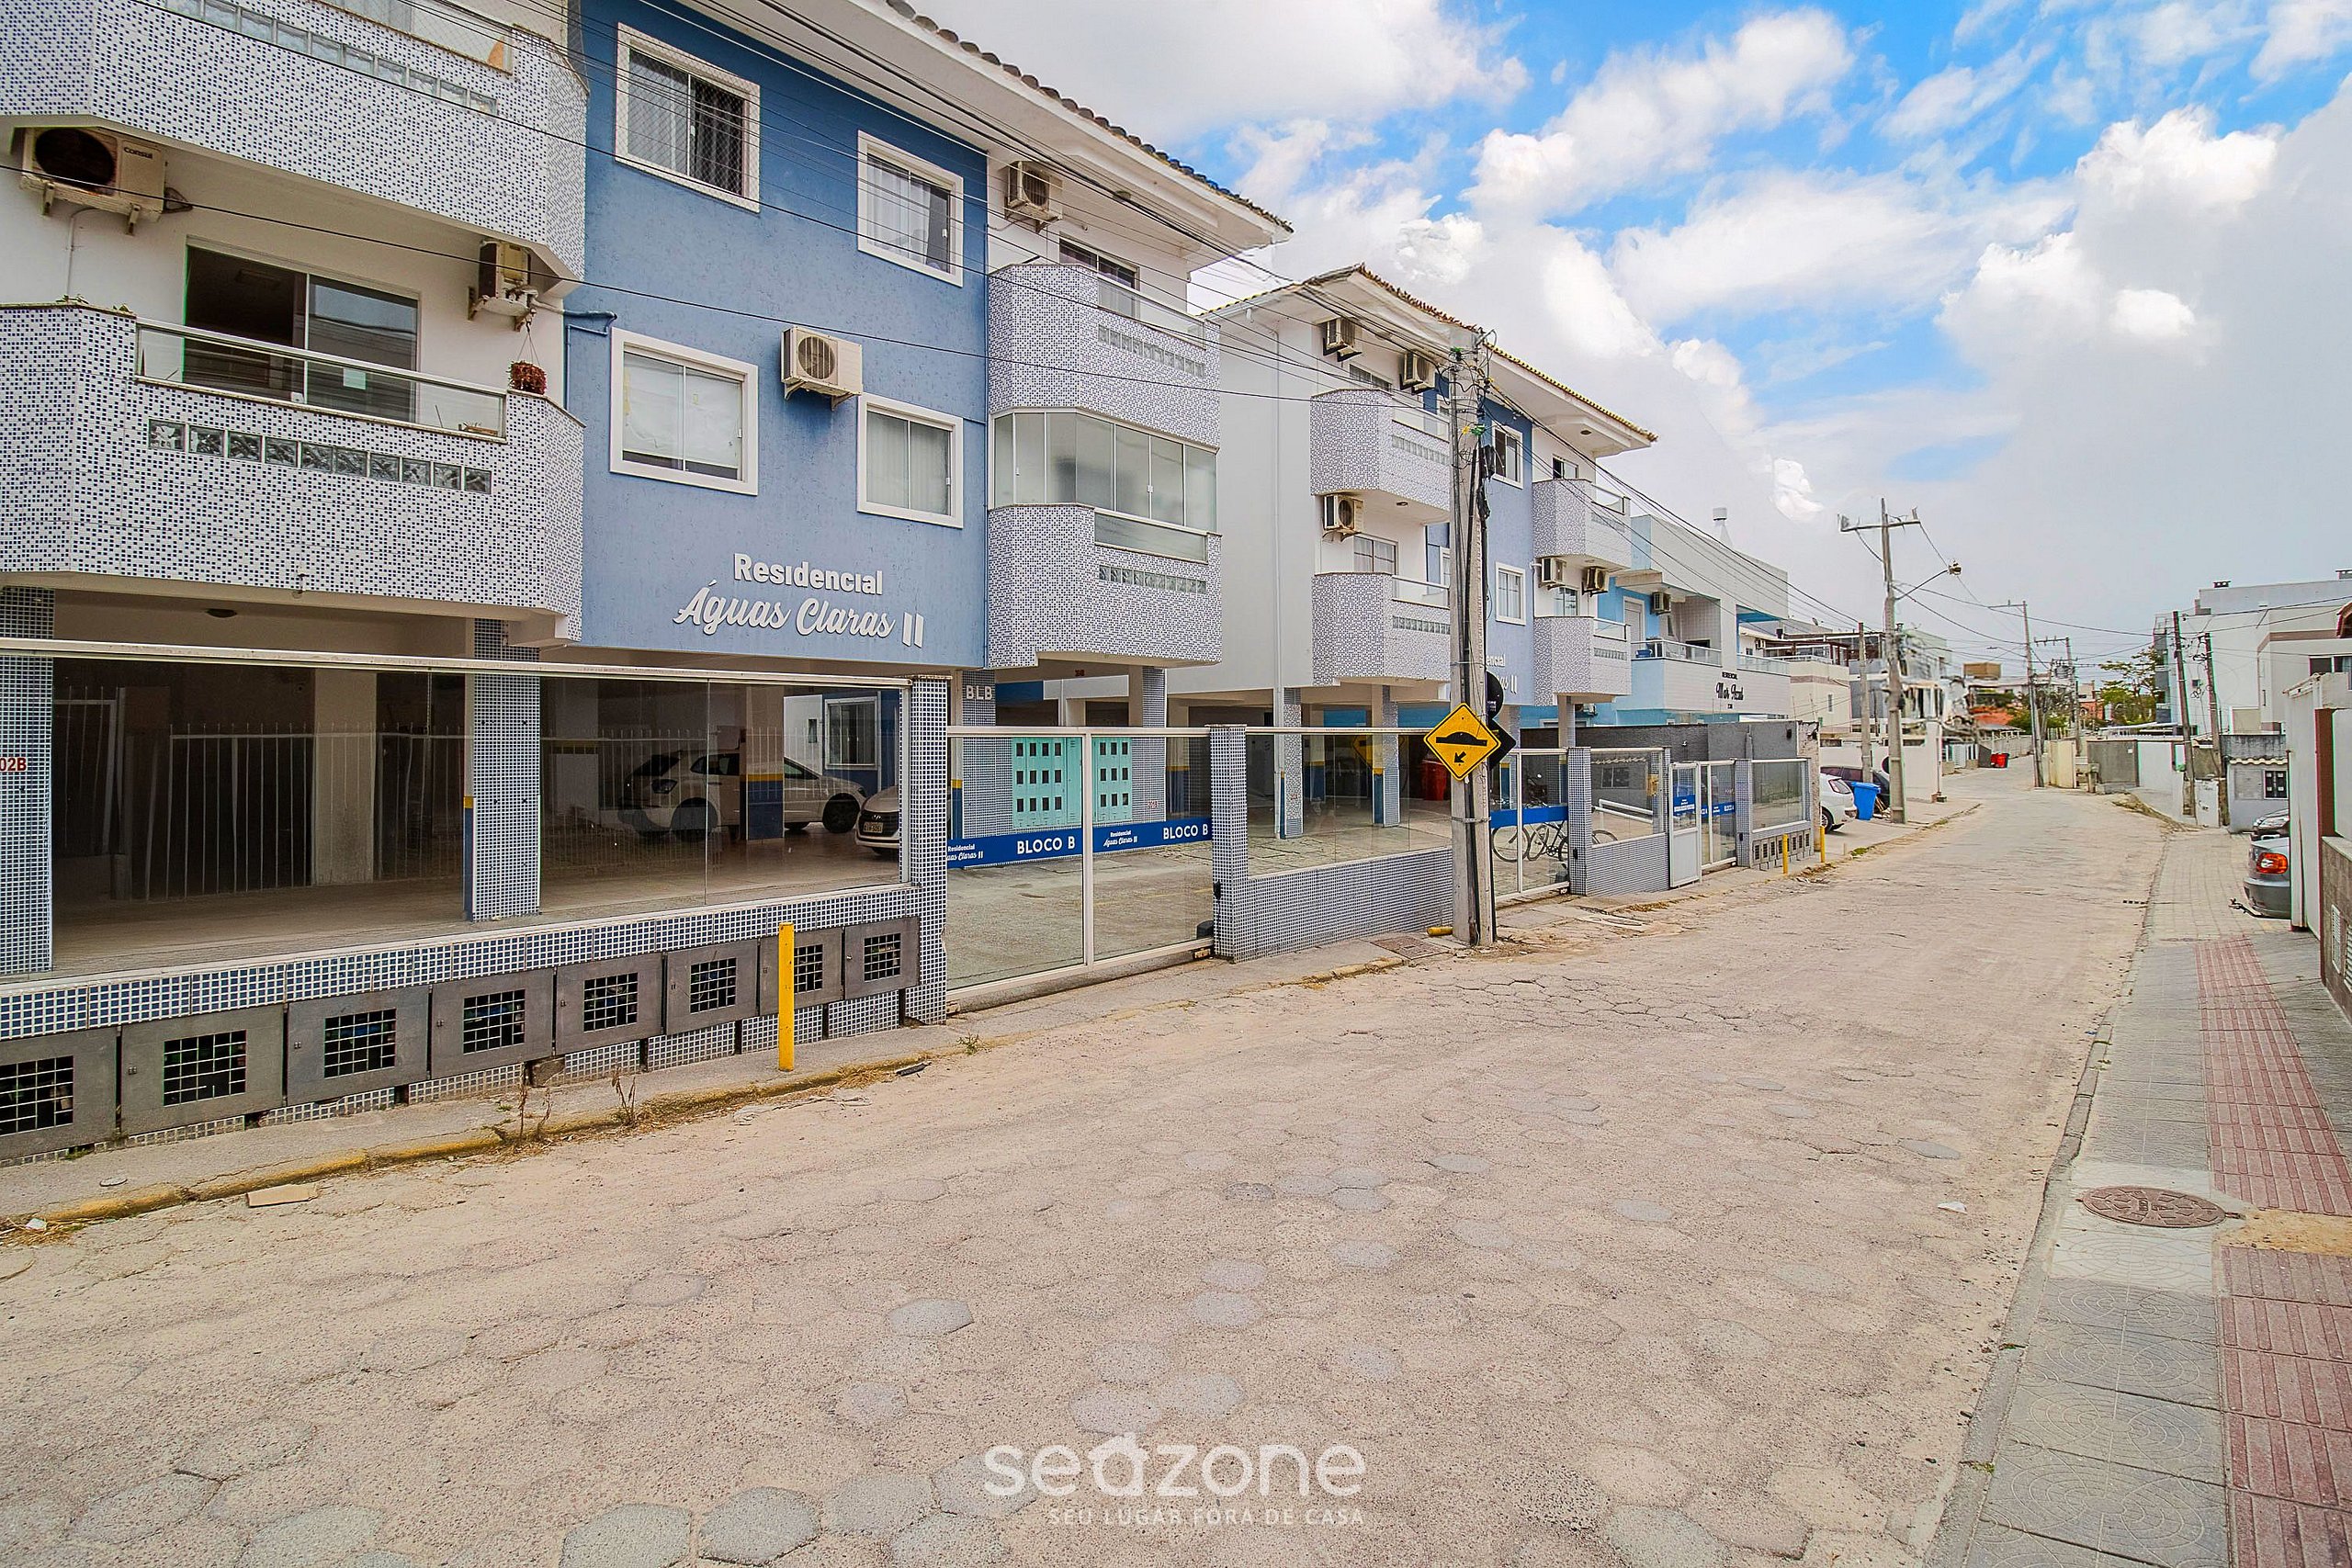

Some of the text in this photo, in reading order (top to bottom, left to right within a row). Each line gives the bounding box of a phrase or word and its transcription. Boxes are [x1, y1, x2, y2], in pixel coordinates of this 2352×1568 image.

[124, 147, 153, 160] Consul
[734, 553, 883, 595] Residencial
[673, 580, 924, 648] Águas Claras II
[1487, 653, 1506, 667] encial
[966, 684, 992, 700] BLB
[1110, 829, 1132, 838] Residencial
[1163, 823, 1209, 840] BLOCO B
[947, 843, 976, 852] Residencial
[1017, 835, 1077, 855] BLOCO B
